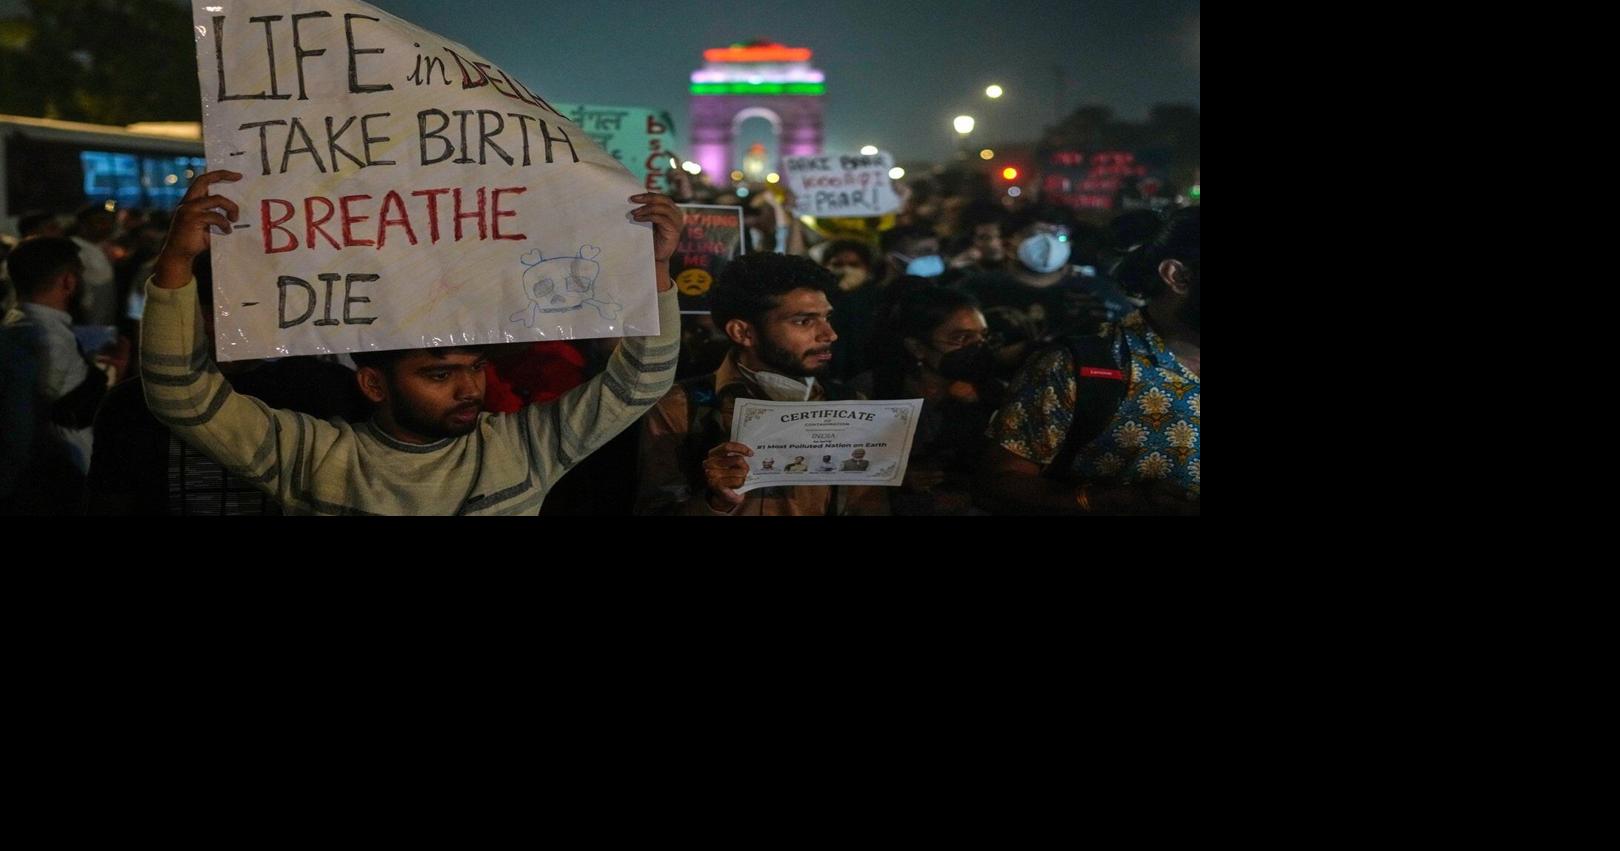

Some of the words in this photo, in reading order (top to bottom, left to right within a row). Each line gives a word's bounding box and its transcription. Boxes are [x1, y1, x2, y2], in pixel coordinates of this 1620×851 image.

[213, 11, 394, 102] LIFE
[406, 42, 452, 86] in
[417, 108, 580, 167] BIRTH
[276, 272, 381, 329] DIE
[780, 409, 876, 424] CERTIFICATE
